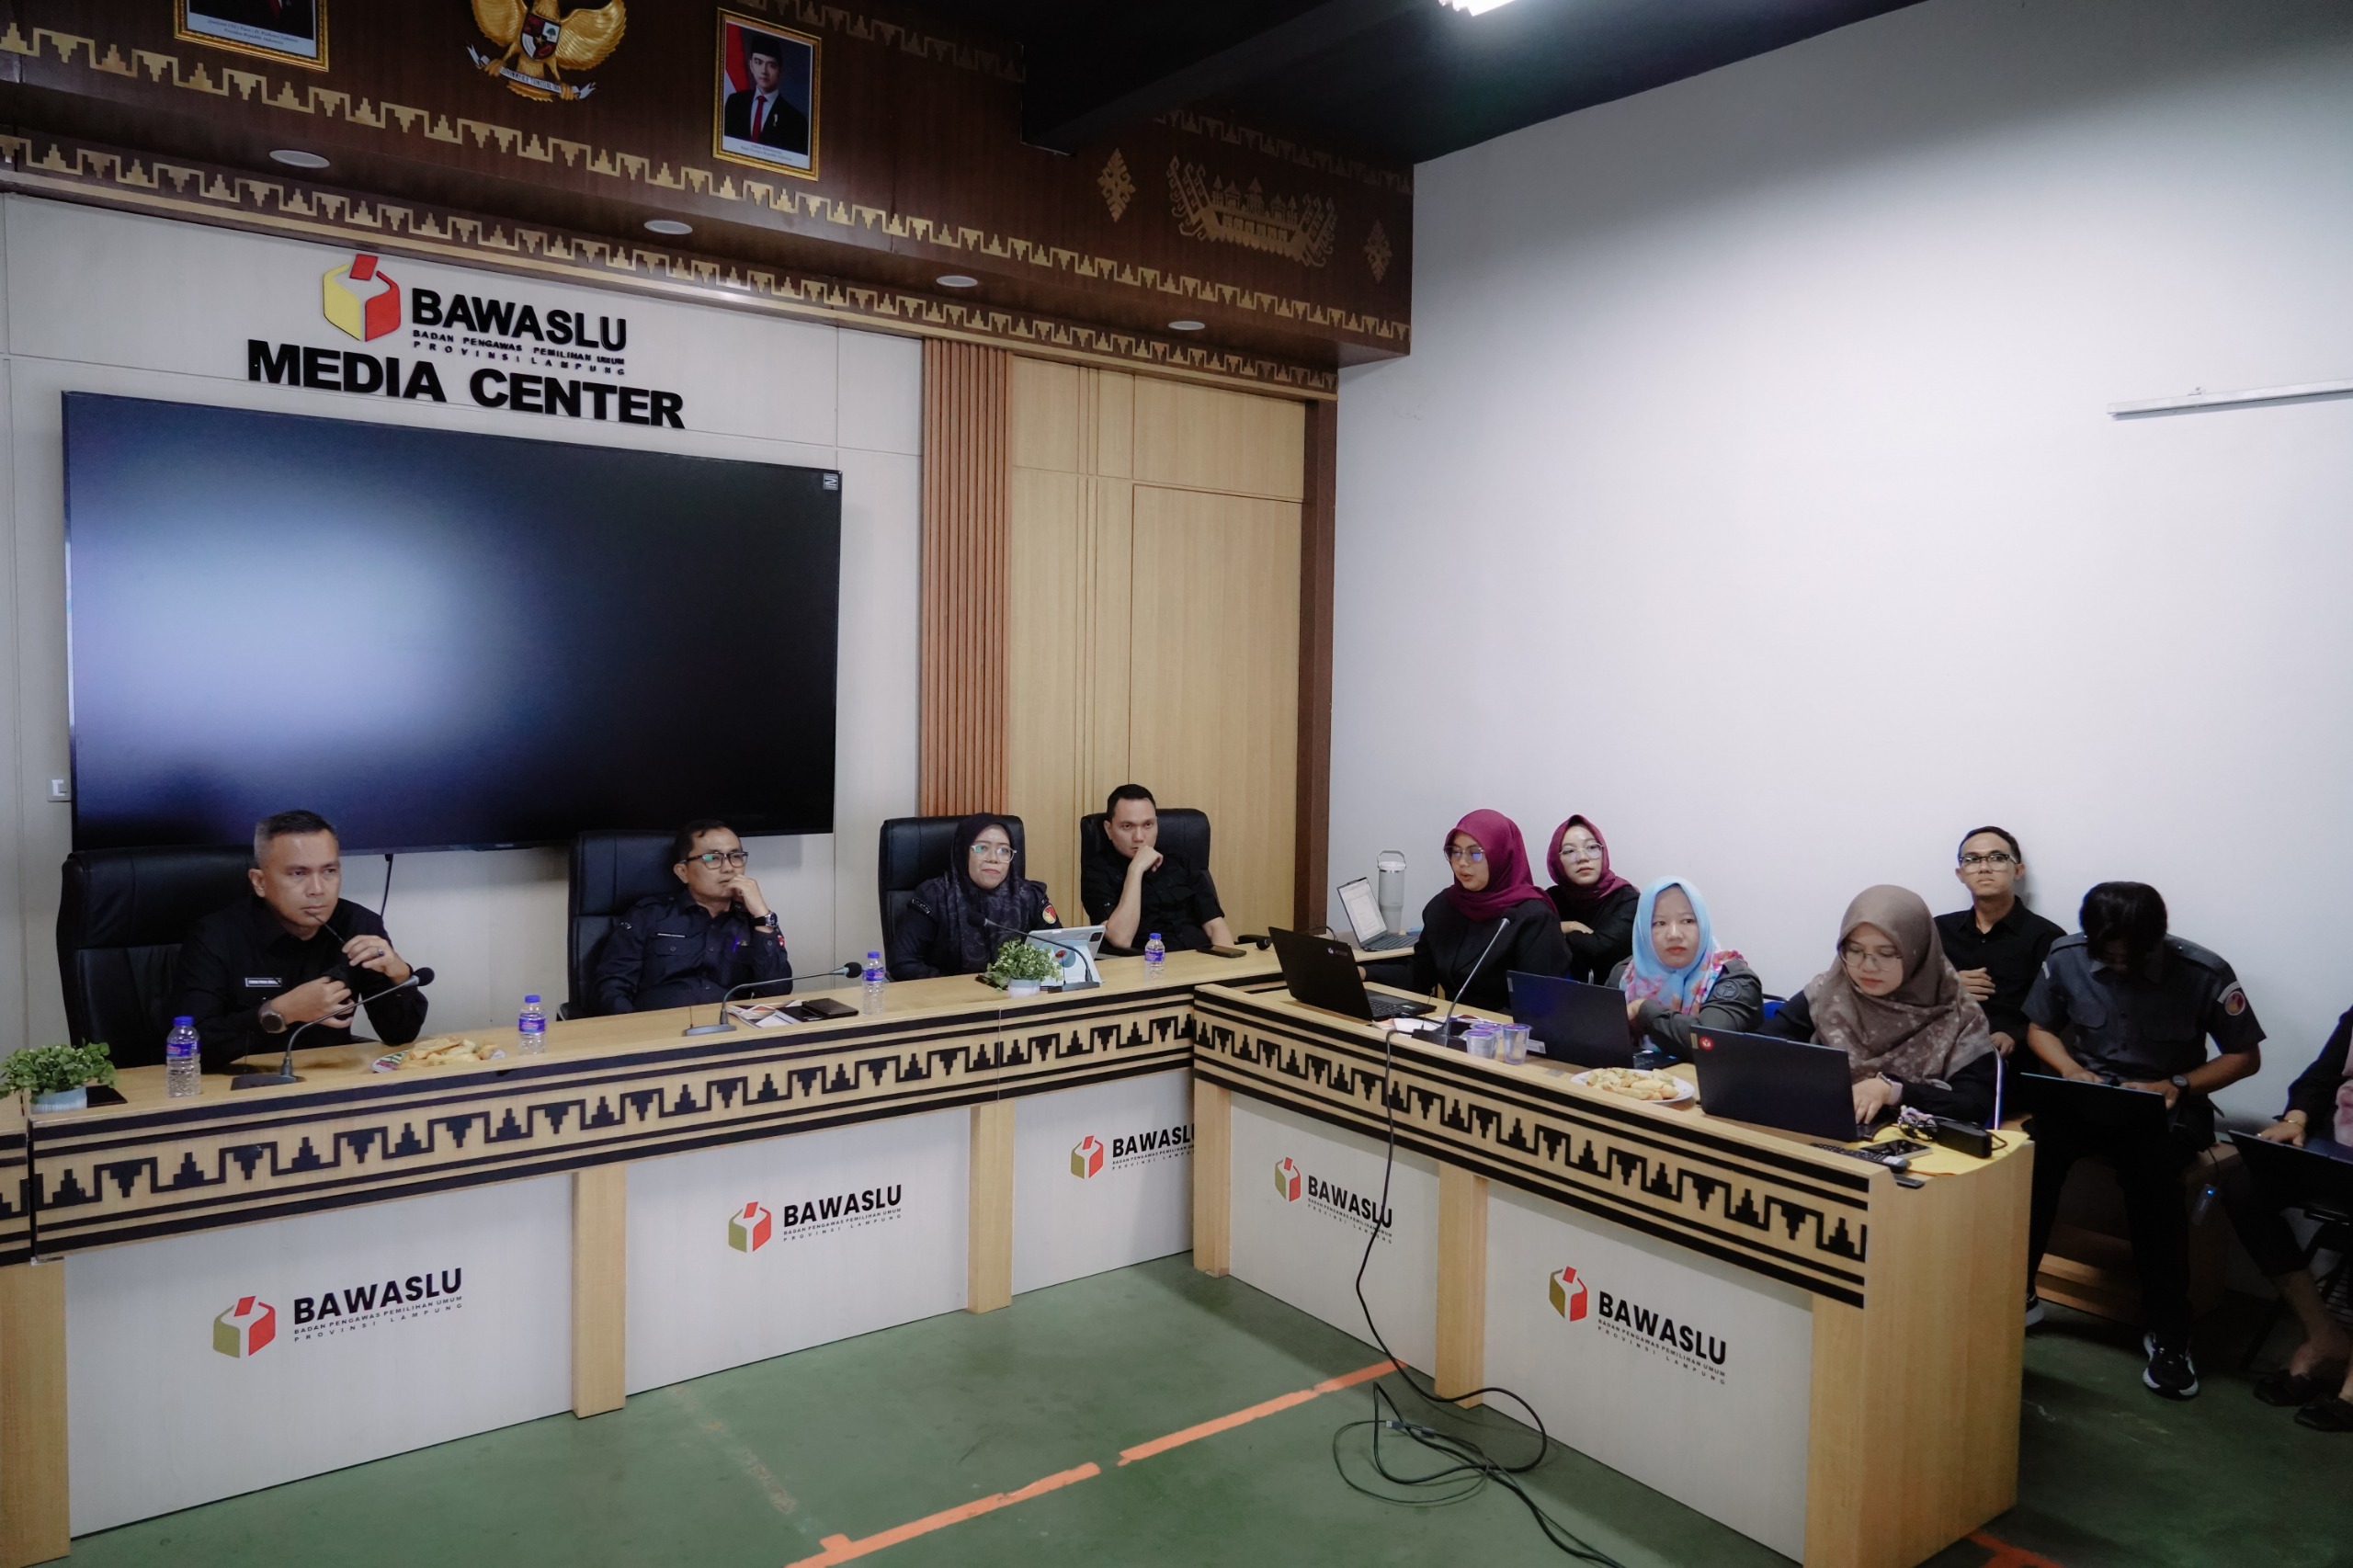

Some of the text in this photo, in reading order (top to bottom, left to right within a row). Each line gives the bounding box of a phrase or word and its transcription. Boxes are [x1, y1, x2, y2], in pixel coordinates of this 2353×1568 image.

[412, 288, 627, 352] BAWASLU
[413, 329, 454, 343] BADAN
[463, 337, 522, 352] PENGAWAS
[533, 347, 592, 361] PEMILIHAN
[414, 341, 625, 376] PROVINSI LAMPUNG
[247, 339, 685, 429] MEDIA CENTER
[783, 1227, 806, 1235] BADAN
[808, 1220, 844, 1230] PENGAWAS
[846, 1212, 881, 1222] PEMILIHAN
[784, 1184, 902, 1227] BAWASLU
[1308, 1175, 1392, 1228] BAWASLU
[783, 1214, 902, 1242] PROVINSI LAMPUNG
[294, 1267, 461, 1324] BAWASLU
[294, 1296, 461, 1335] BADAN PENGAWAS PEMILIHAN UMUM
[294, 1303, 461, 1342] PROVINSI LAMPUNG
[1599, 1290, 1726, 1365] BAWASLU
[1598, 1318, 1725, 1377] BADAN PENGAWAS PEMILIHAN UMUM
[1598, 1326, 1725, 1385] PROVINSI LAMPUNG
